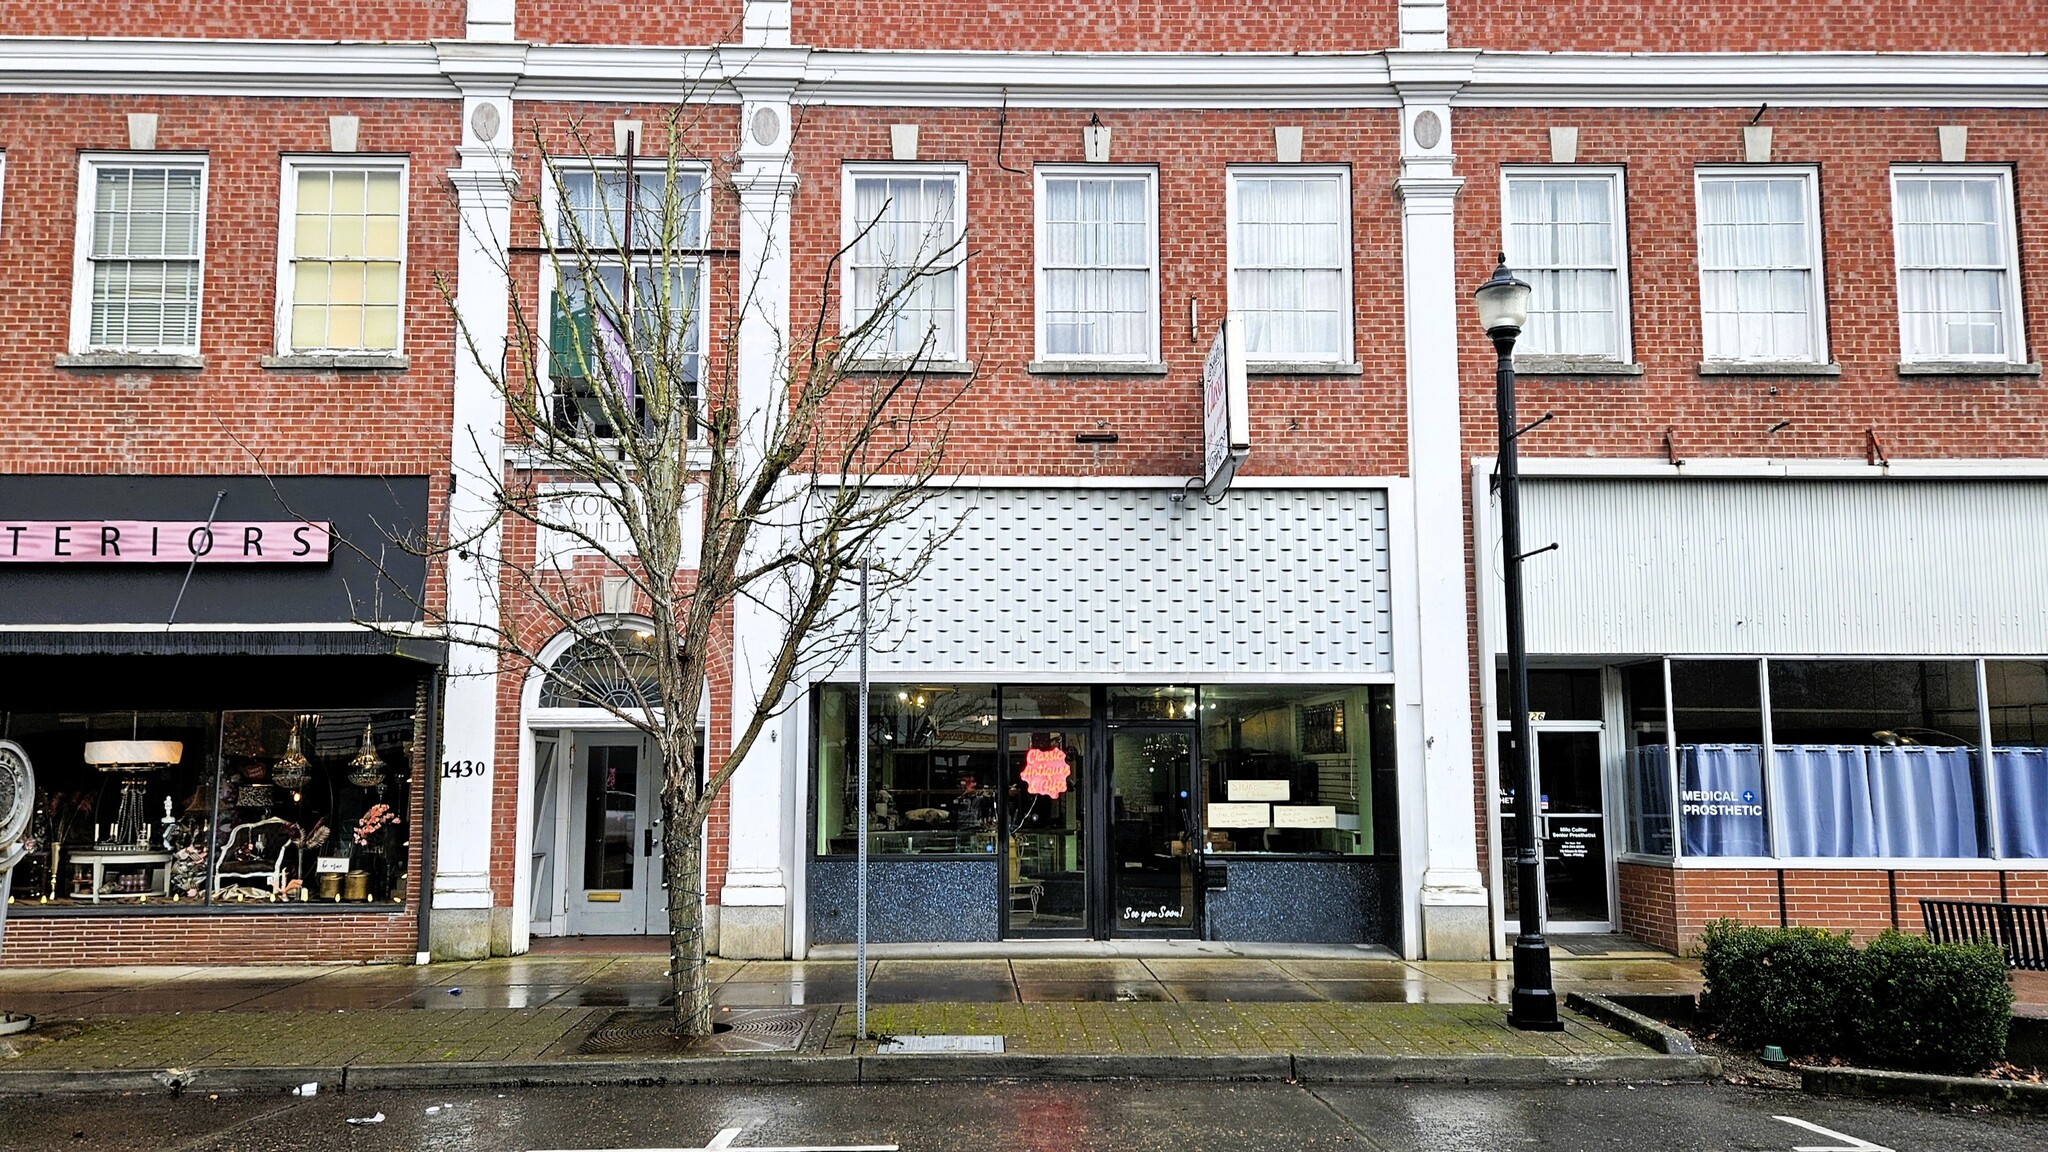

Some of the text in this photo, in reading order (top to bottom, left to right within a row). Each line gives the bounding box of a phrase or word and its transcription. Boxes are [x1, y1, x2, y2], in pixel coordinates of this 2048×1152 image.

[6, 526, 311, 557] TERIORS
[1027, 748, 1064, 763] Classic
[441, 760, 485, 778] 1430
[1023, 763, 1069, 781] Antiques
[1029, 780, 1065, 797] & Gifts
[1682, 791, 1739, 801] MEDICAL
[1683, 804, 1763, 816] PROSTHETIC
[1124, 905, 1185, 923] See you Soon!
